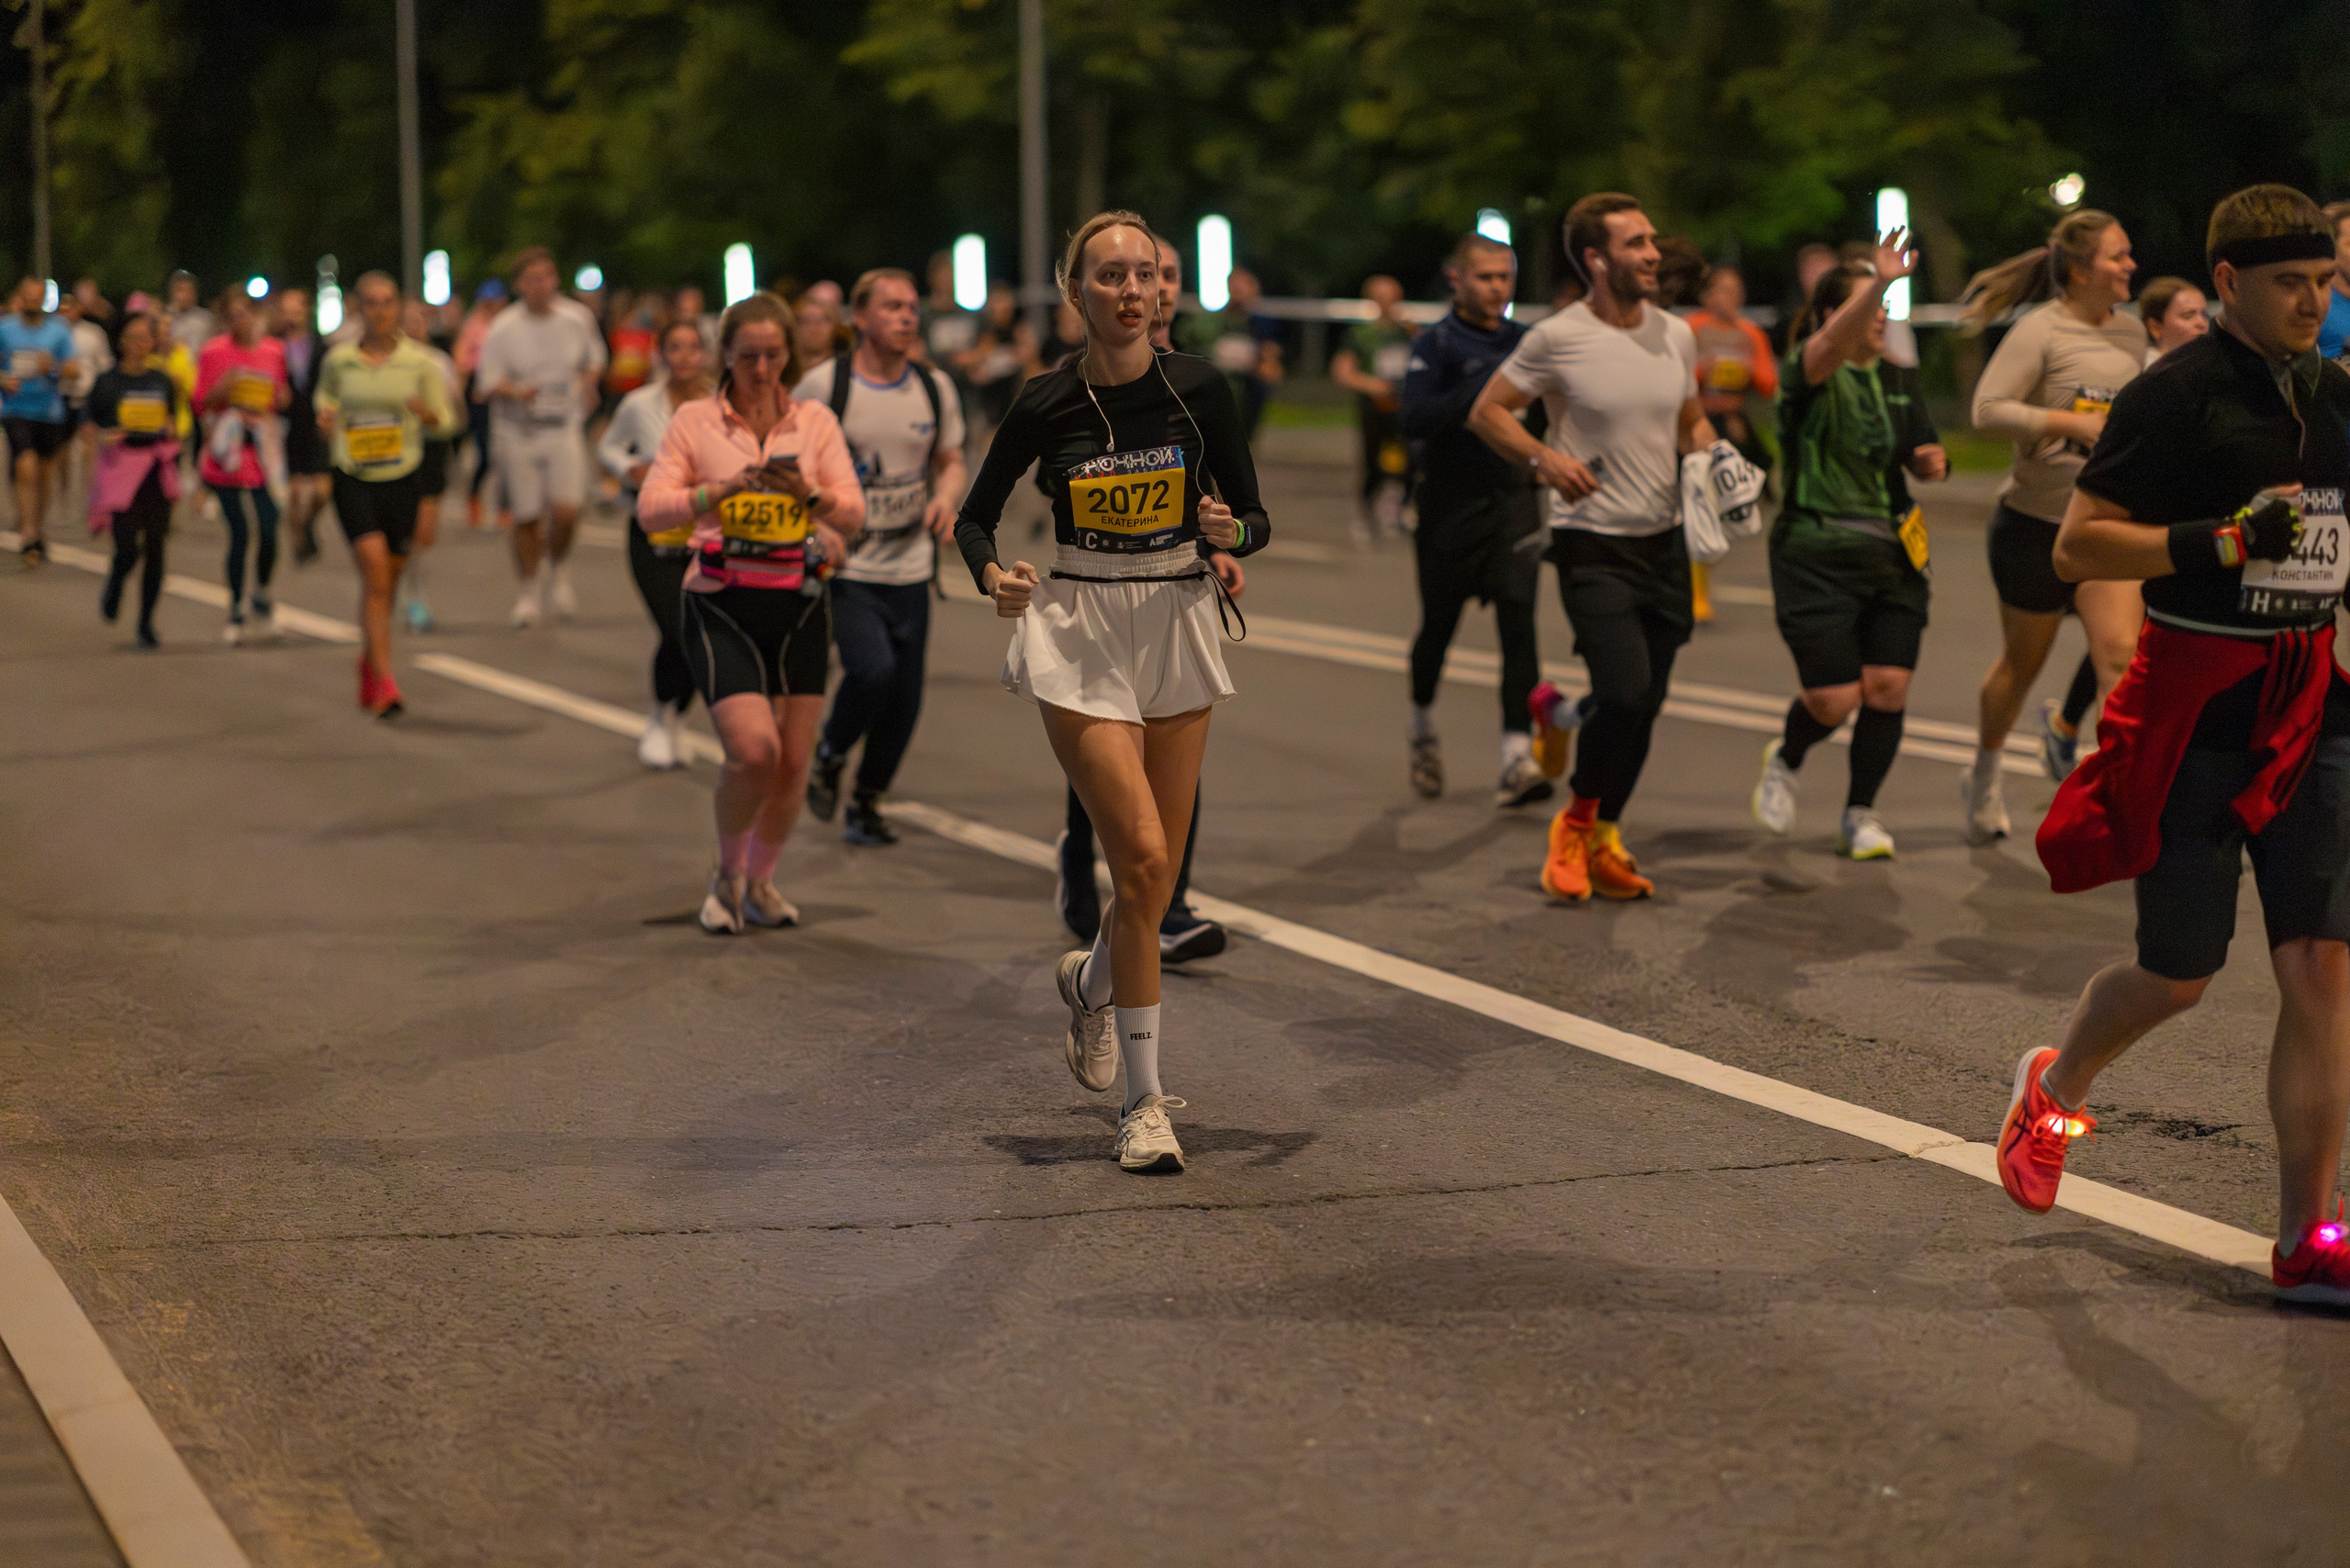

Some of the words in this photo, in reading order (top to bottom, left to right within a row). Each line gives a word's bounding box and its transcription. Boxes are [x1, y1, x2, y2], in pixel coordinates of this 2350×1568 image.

[1087, 479, 1169, 515] 2072
[726, 501, 803, 528] 12519
[1102, 515, 1159, 528] ЕКАТЕРИНА
[2271, 570, 2333, 581] КОНСТАНТИН
[1130, 1031, 1153, 1041] FEELZ
